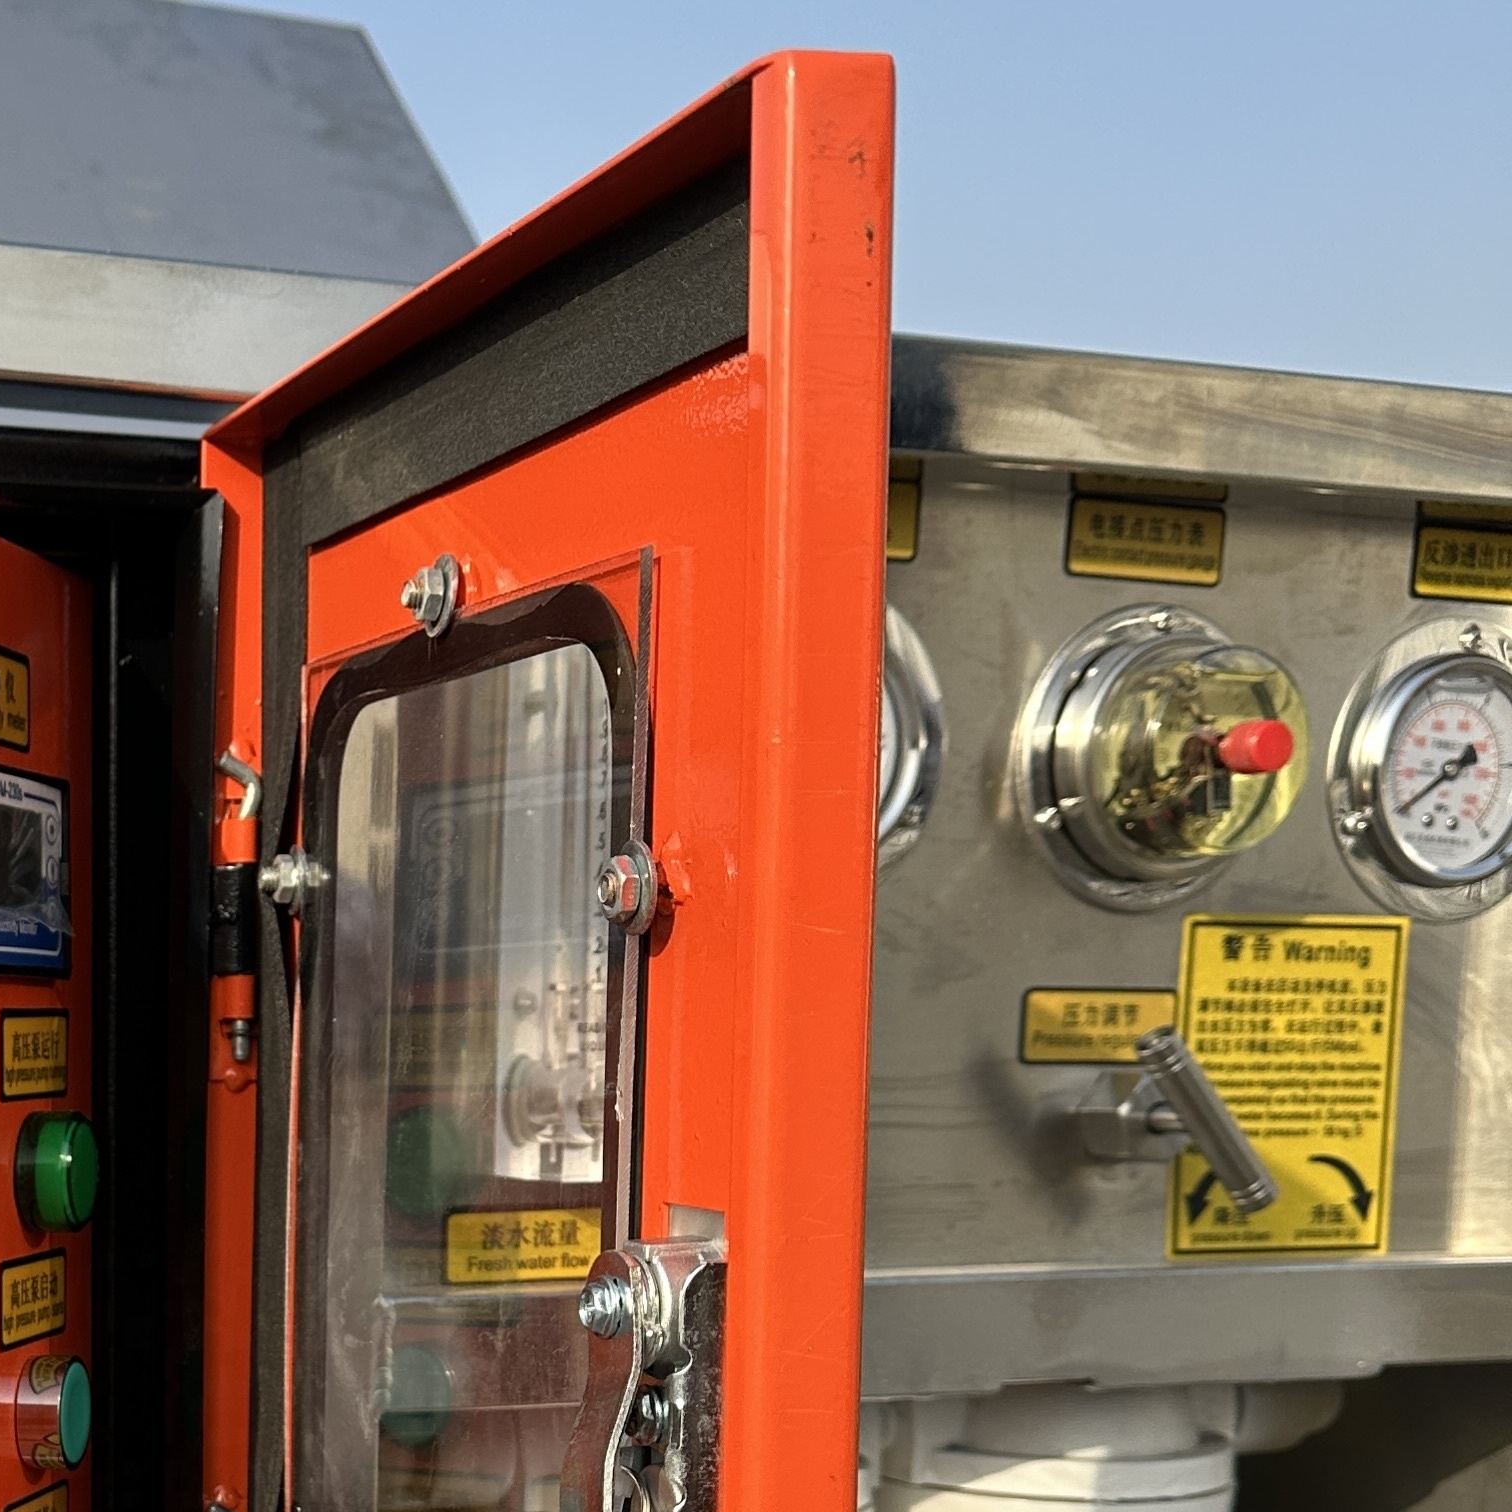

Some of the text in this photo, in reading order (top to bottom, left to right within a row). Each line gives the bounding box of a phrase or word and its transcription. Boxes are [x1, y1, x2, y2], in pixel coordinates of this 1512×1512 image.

[1282, 938, 1373, 969] Warning
[481, 1218, 581, 1250] 淡水流量
[466, 1251, 592, 1273] Fresh water flow
